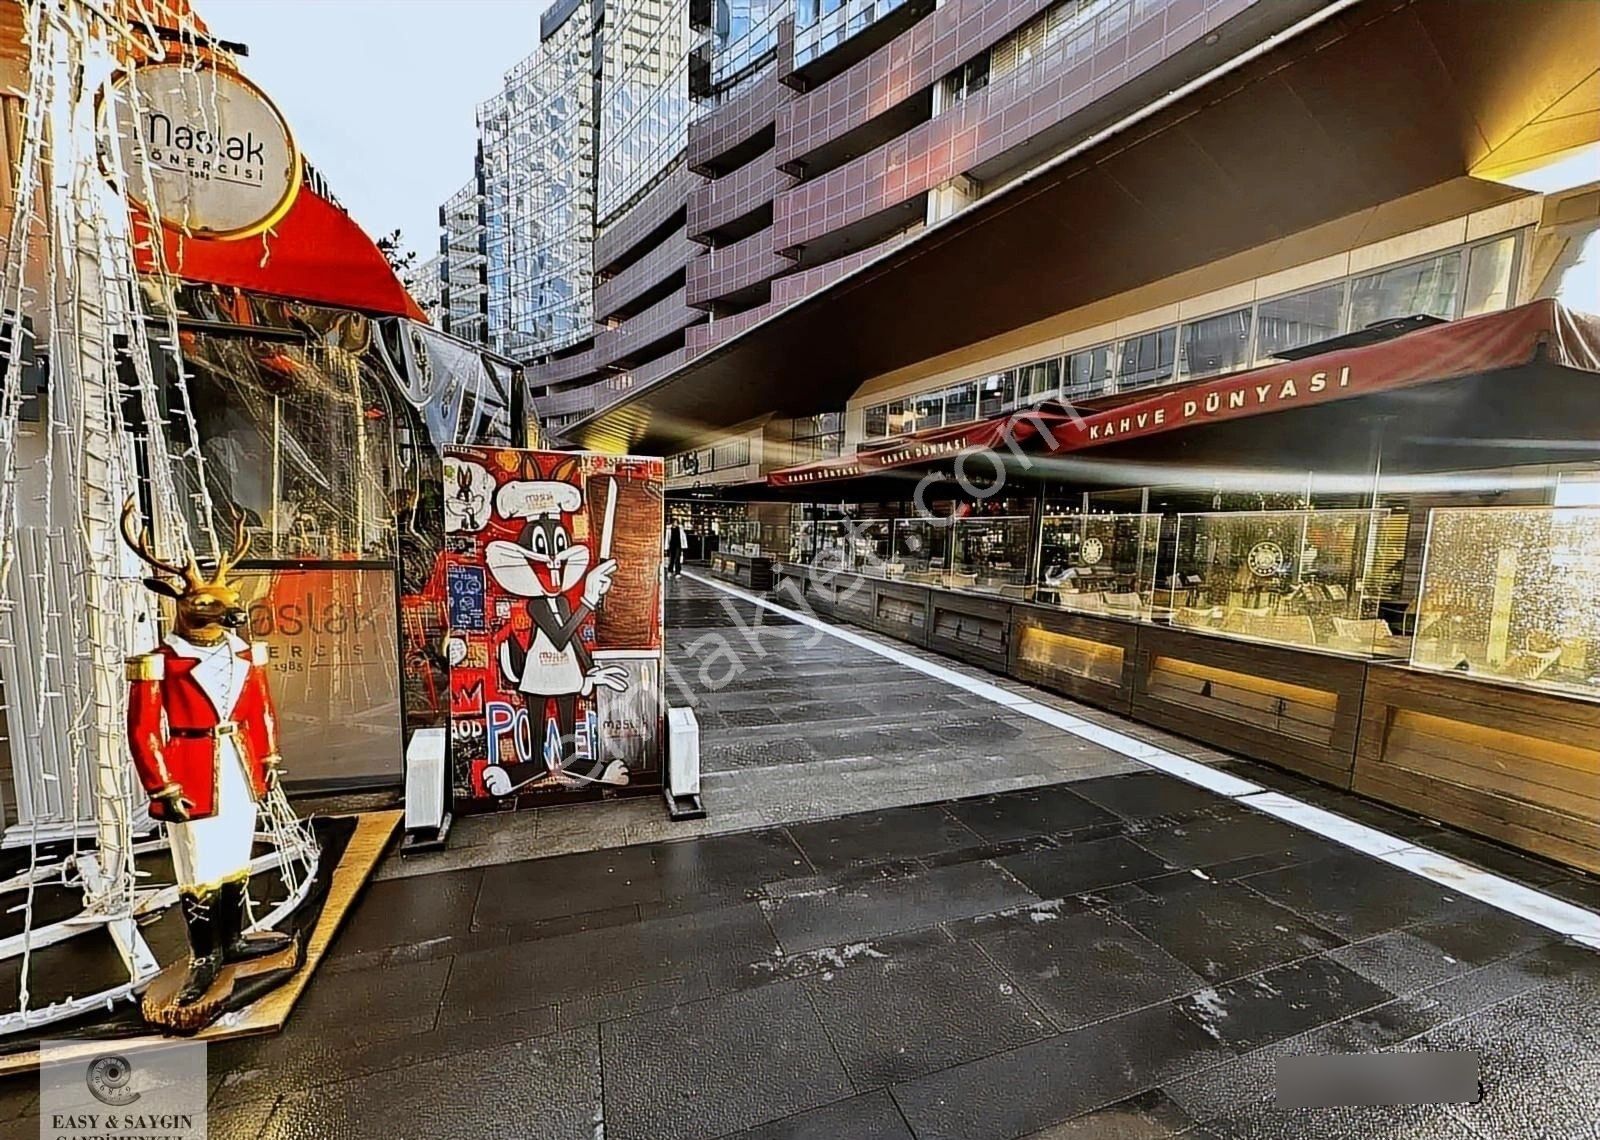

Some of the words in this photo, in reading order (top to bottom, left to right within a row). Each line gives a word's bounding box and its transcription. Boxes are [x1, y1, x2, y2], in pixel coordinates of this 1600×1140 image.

[1089, 408, 1165, 440] KAHVE
[1184, 366, 1350, 418] DÜNYASI
[249, 592, 378, 637] aslak
